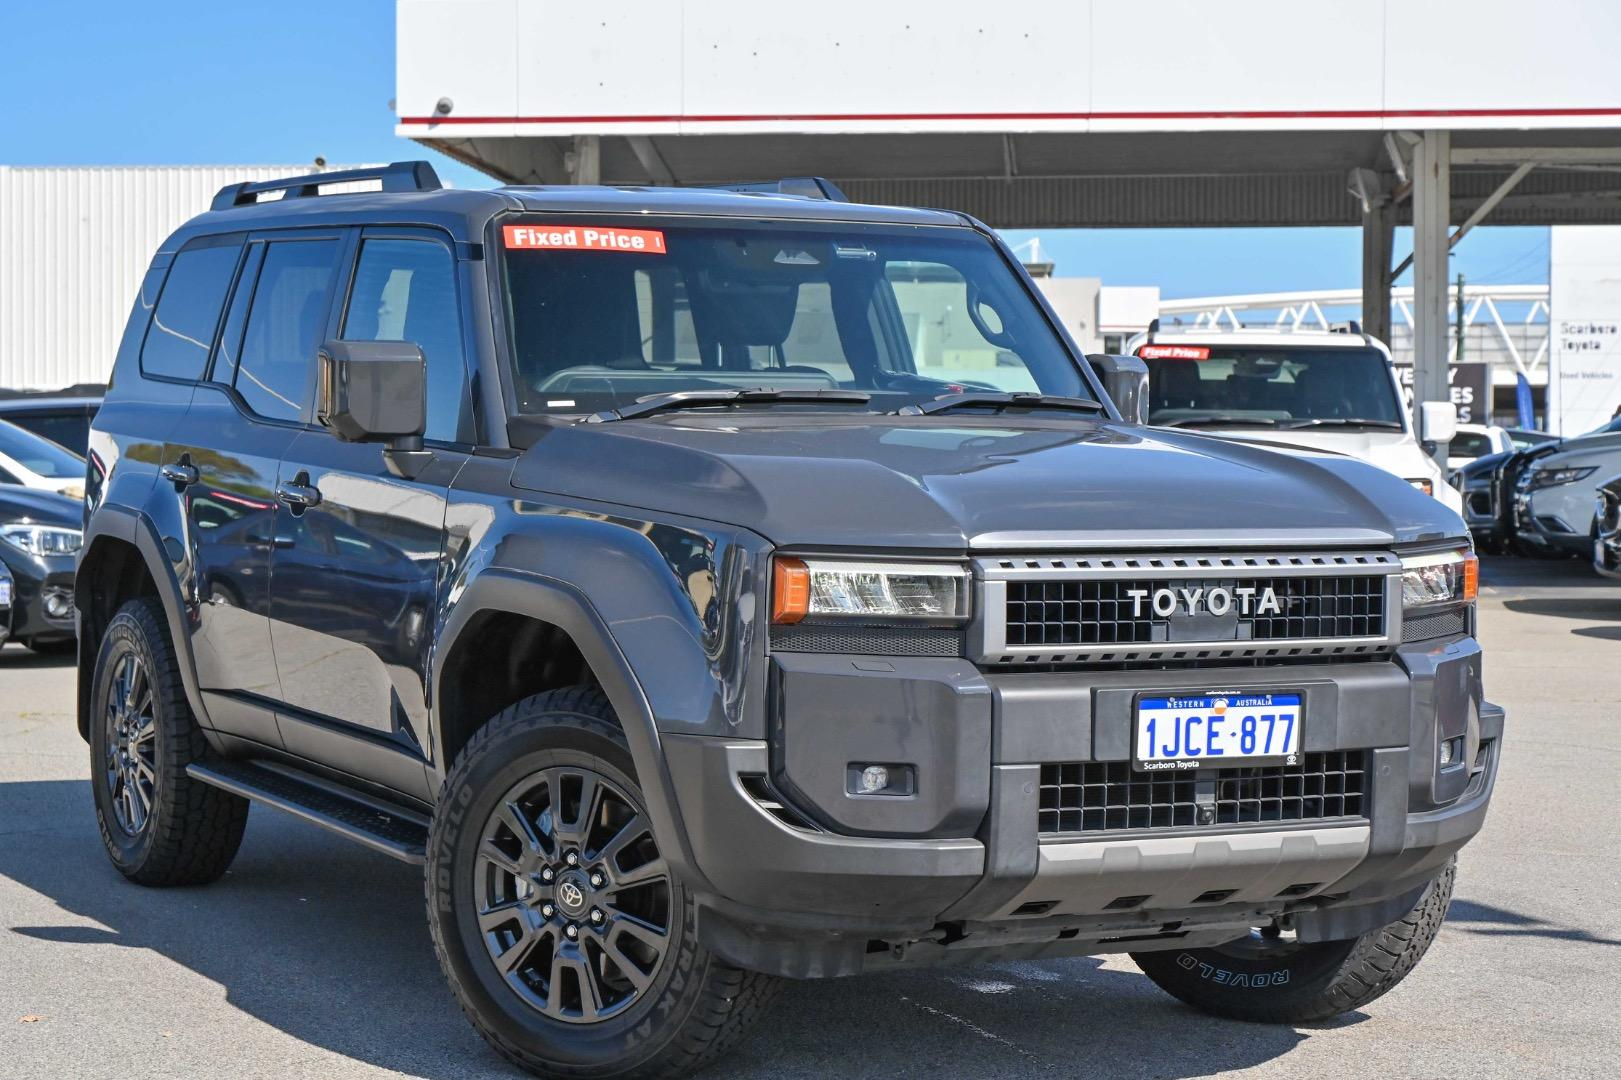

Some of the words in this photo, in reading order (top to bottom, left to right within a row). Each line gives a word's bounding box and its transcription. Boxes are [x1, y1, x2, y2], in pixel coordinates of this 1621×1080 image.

[513, 229, 577, 246] Fixed
[583, 230, 645, 249] Price
[1560, 338, 1601, 353] Toyota
[1127, 587, 1281, 617] TOYOTA
[1166, 700, 1204, 709] WESTERN
[1235, 698, 1273, 707] AUSTRALIA
[1143, 761, 1176, 770] Scarboro
[1176, 760, 1200, 769] Toyota
[1176, 952, 1290, 988] ROVELO
